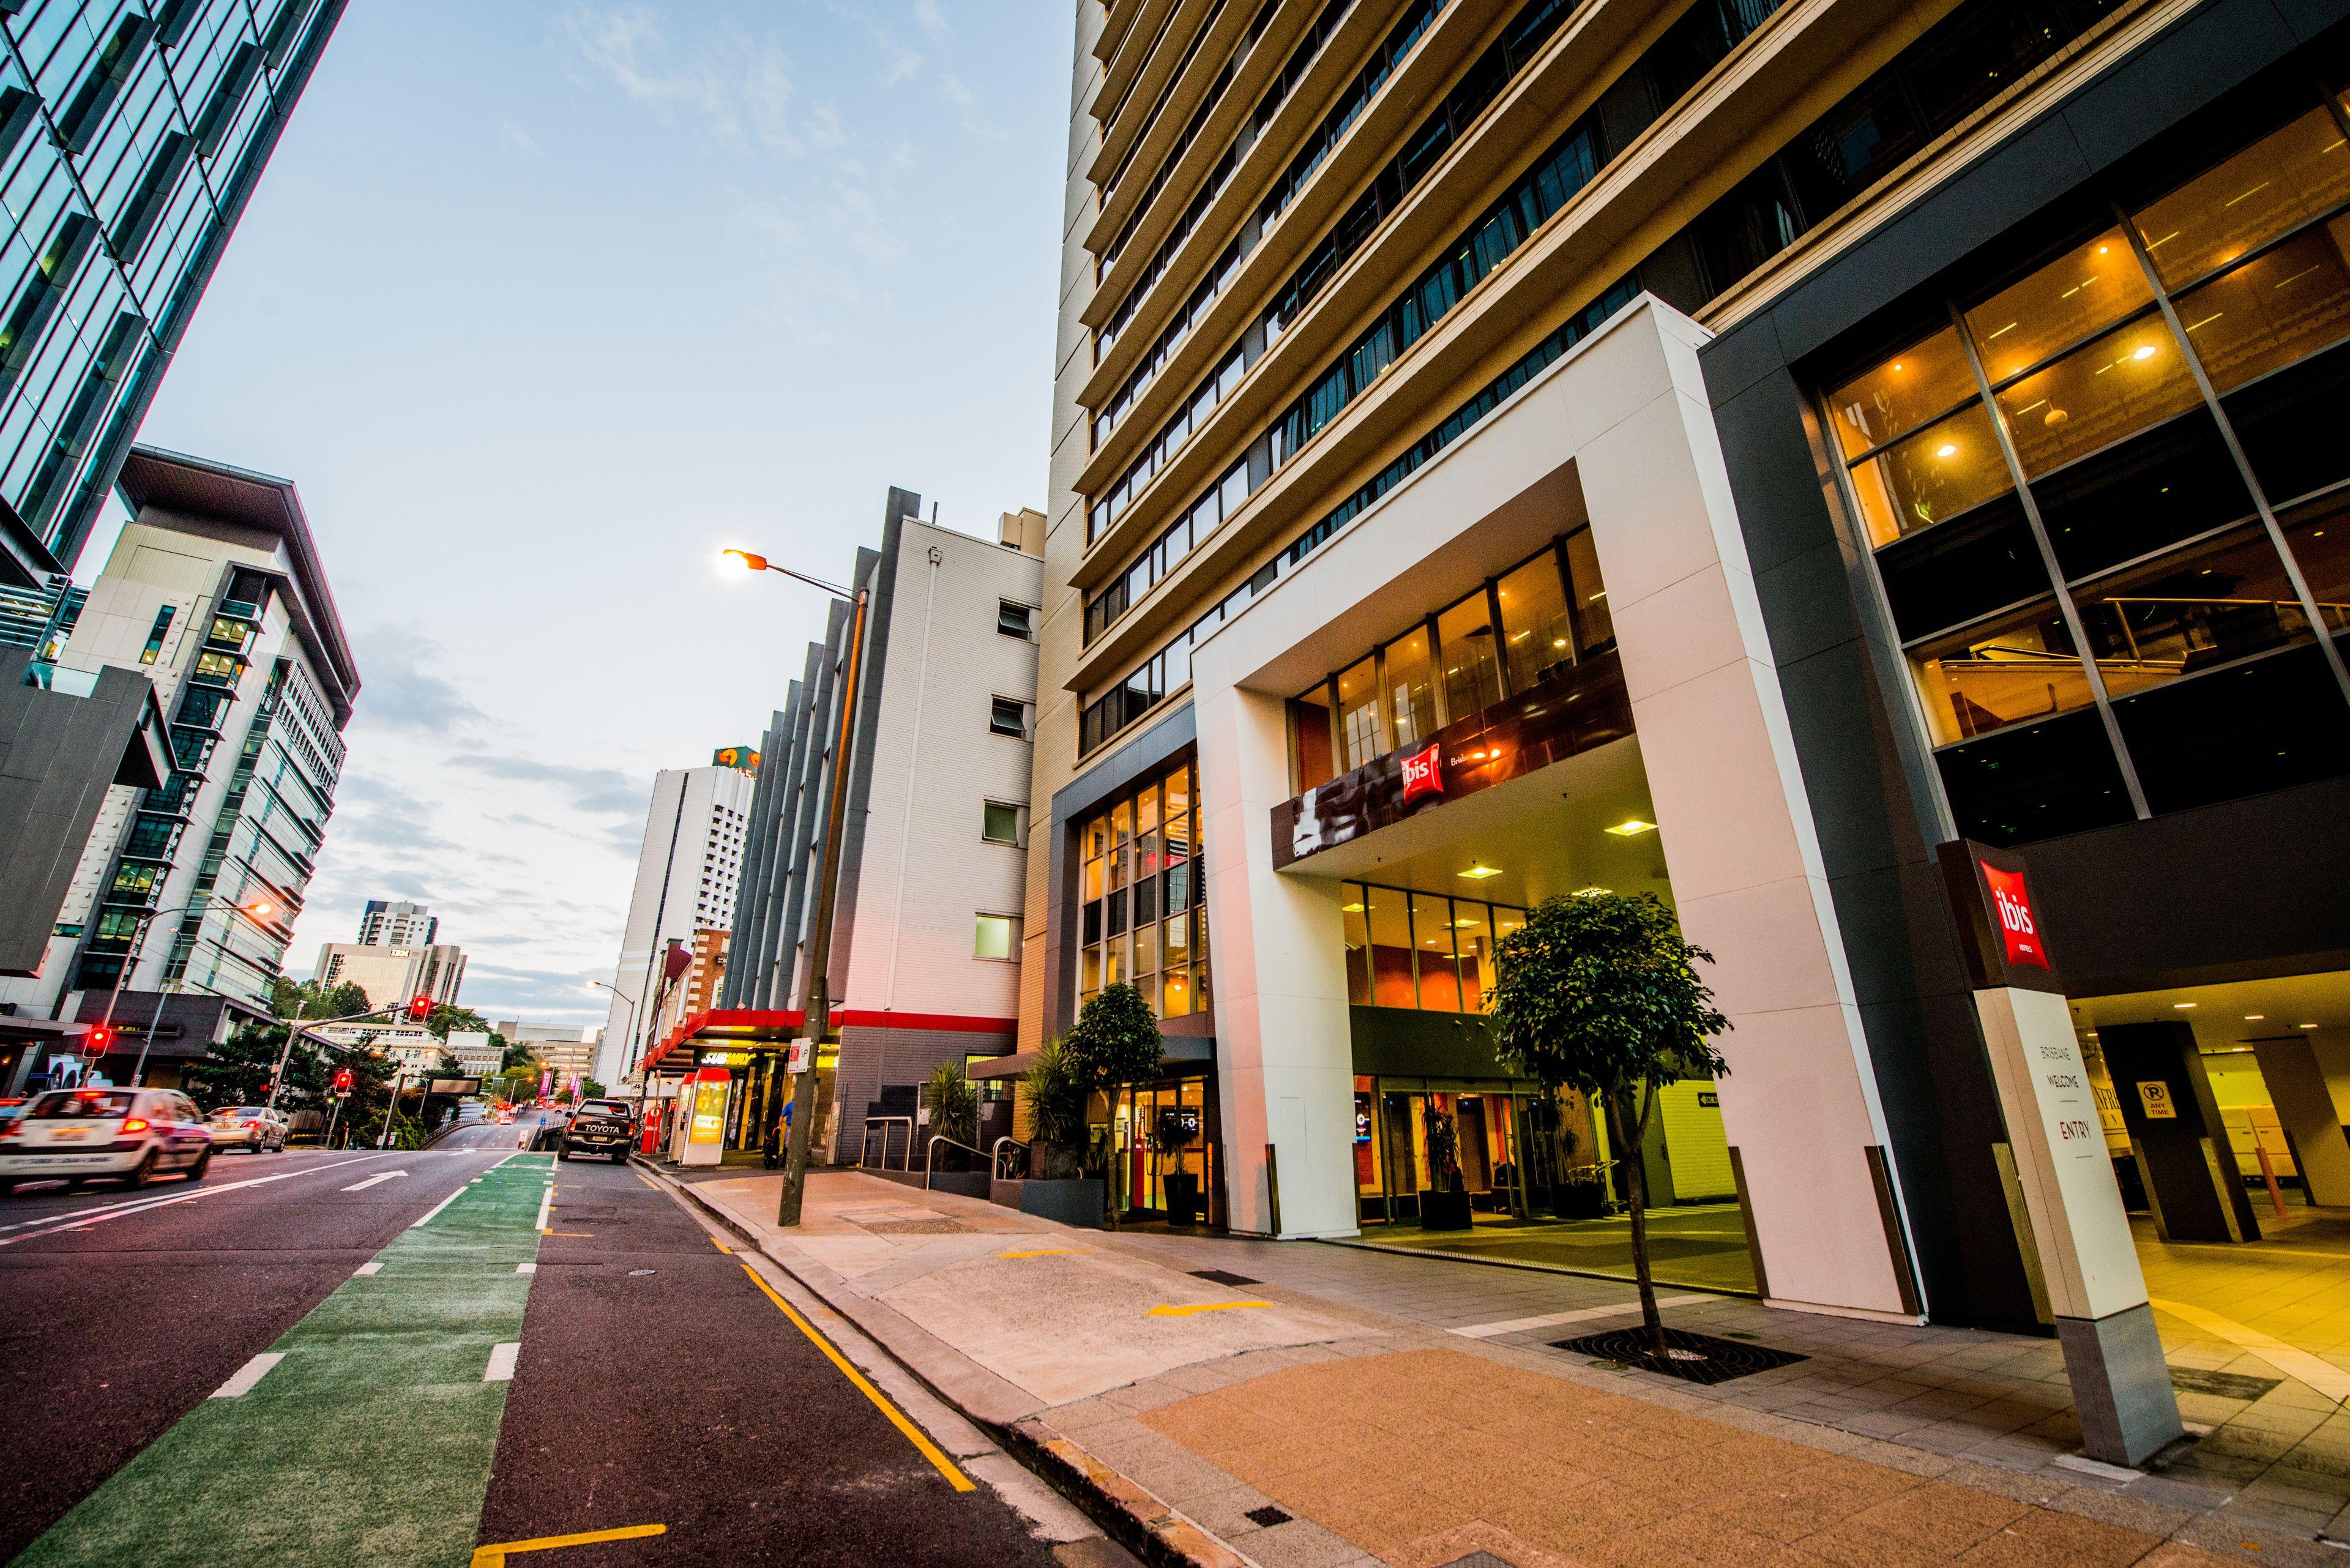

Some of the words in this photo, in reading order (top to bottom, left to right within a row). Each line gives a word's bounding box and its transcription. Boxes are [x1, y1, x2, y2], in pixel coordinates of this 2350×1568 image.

[1401, 760, 1430, 785] ibis
[1995, 889, 2034, 935] ibis
[390, 949, 410, 957] IBM
[2018, 943, 2033, 953] HOTELS
[701, 1051, 757, 1066] SUBWAY
[2040, 1046, 2072, 1061] BRISBANE
[2046, 1075, 2080, 1088] WELCOME
[585, 1124, 620, 1133] TOYOTA
[2059, 1121, 2092, 1140] ENTRY
